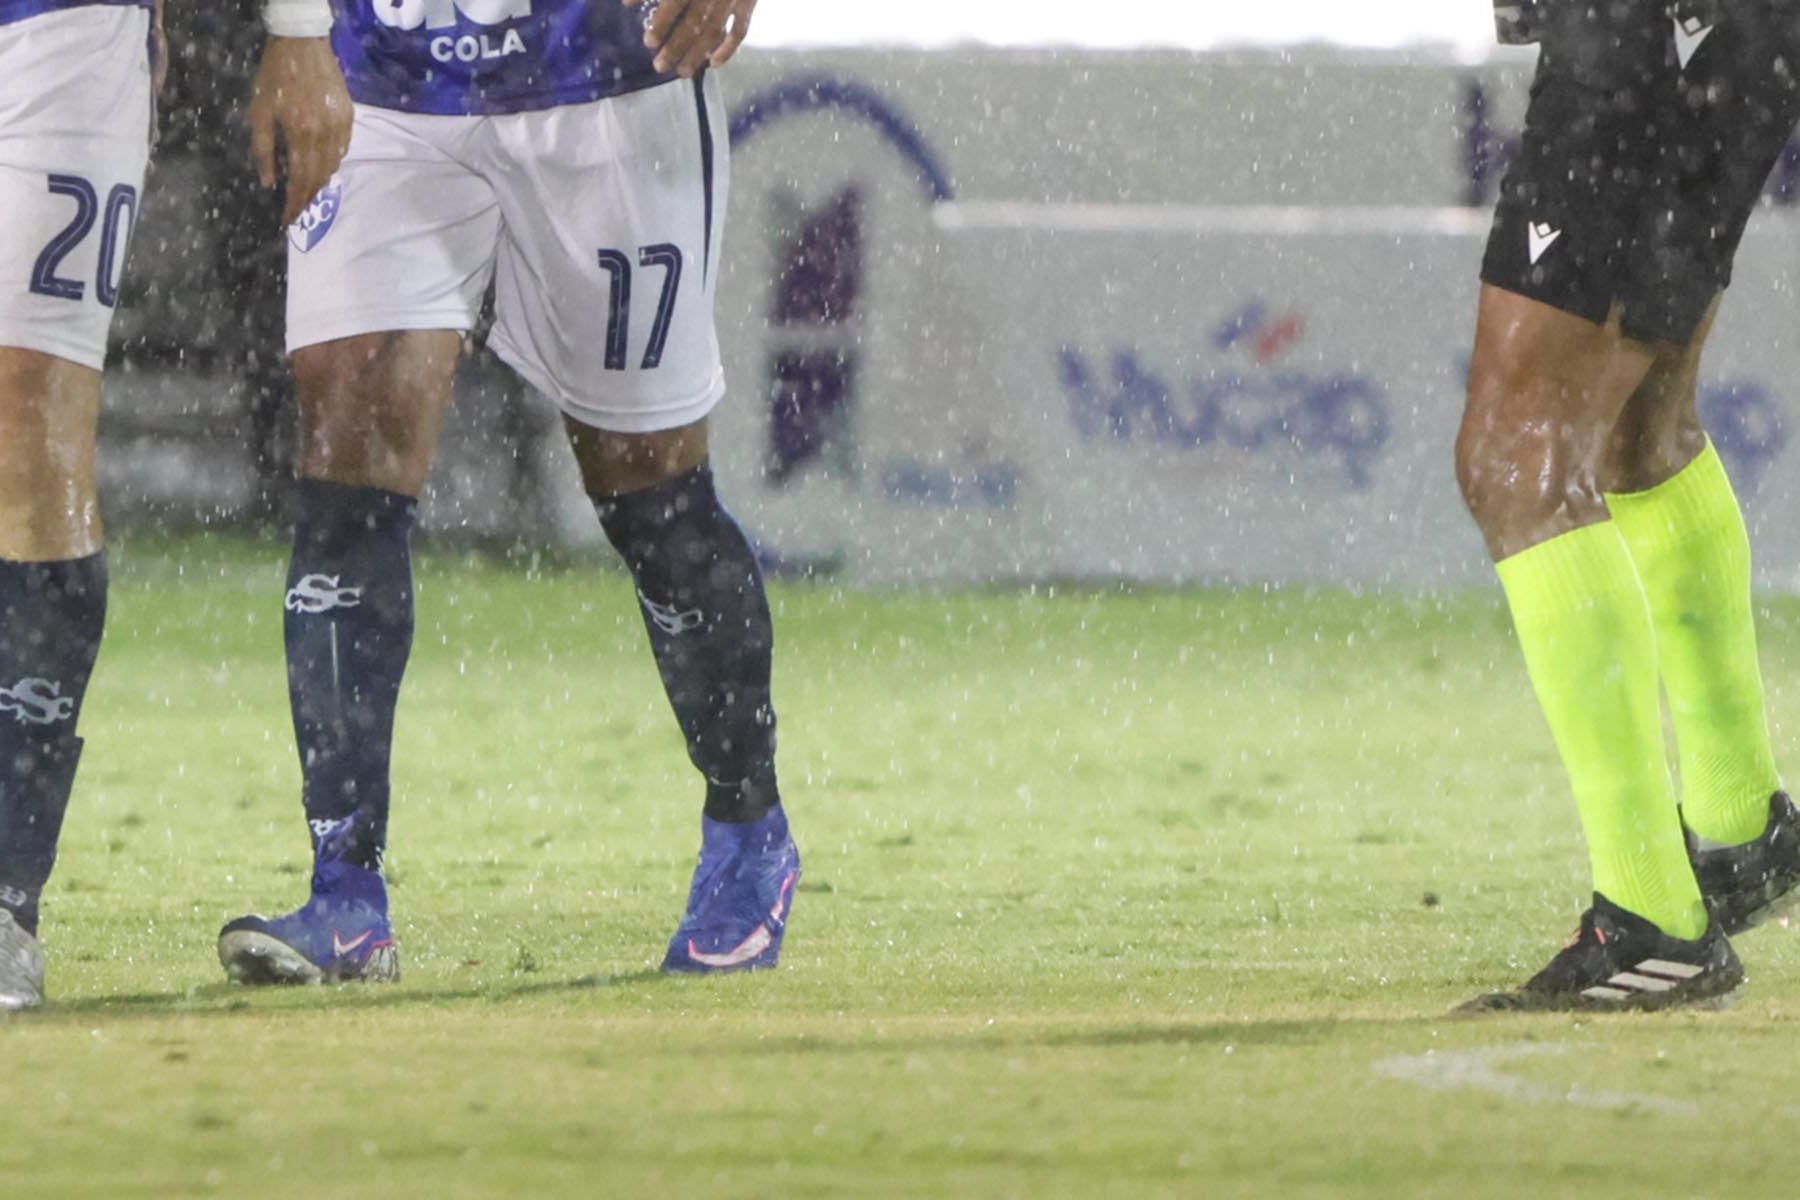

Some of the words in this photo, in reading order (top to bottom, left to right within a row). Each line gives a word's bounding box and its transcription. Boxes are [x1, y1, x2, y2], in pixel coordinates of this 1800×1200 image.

[430, 29, 527, 63] COLA
[28, 173, 137, 307] 20
[598, 243, 683, 371] 17
